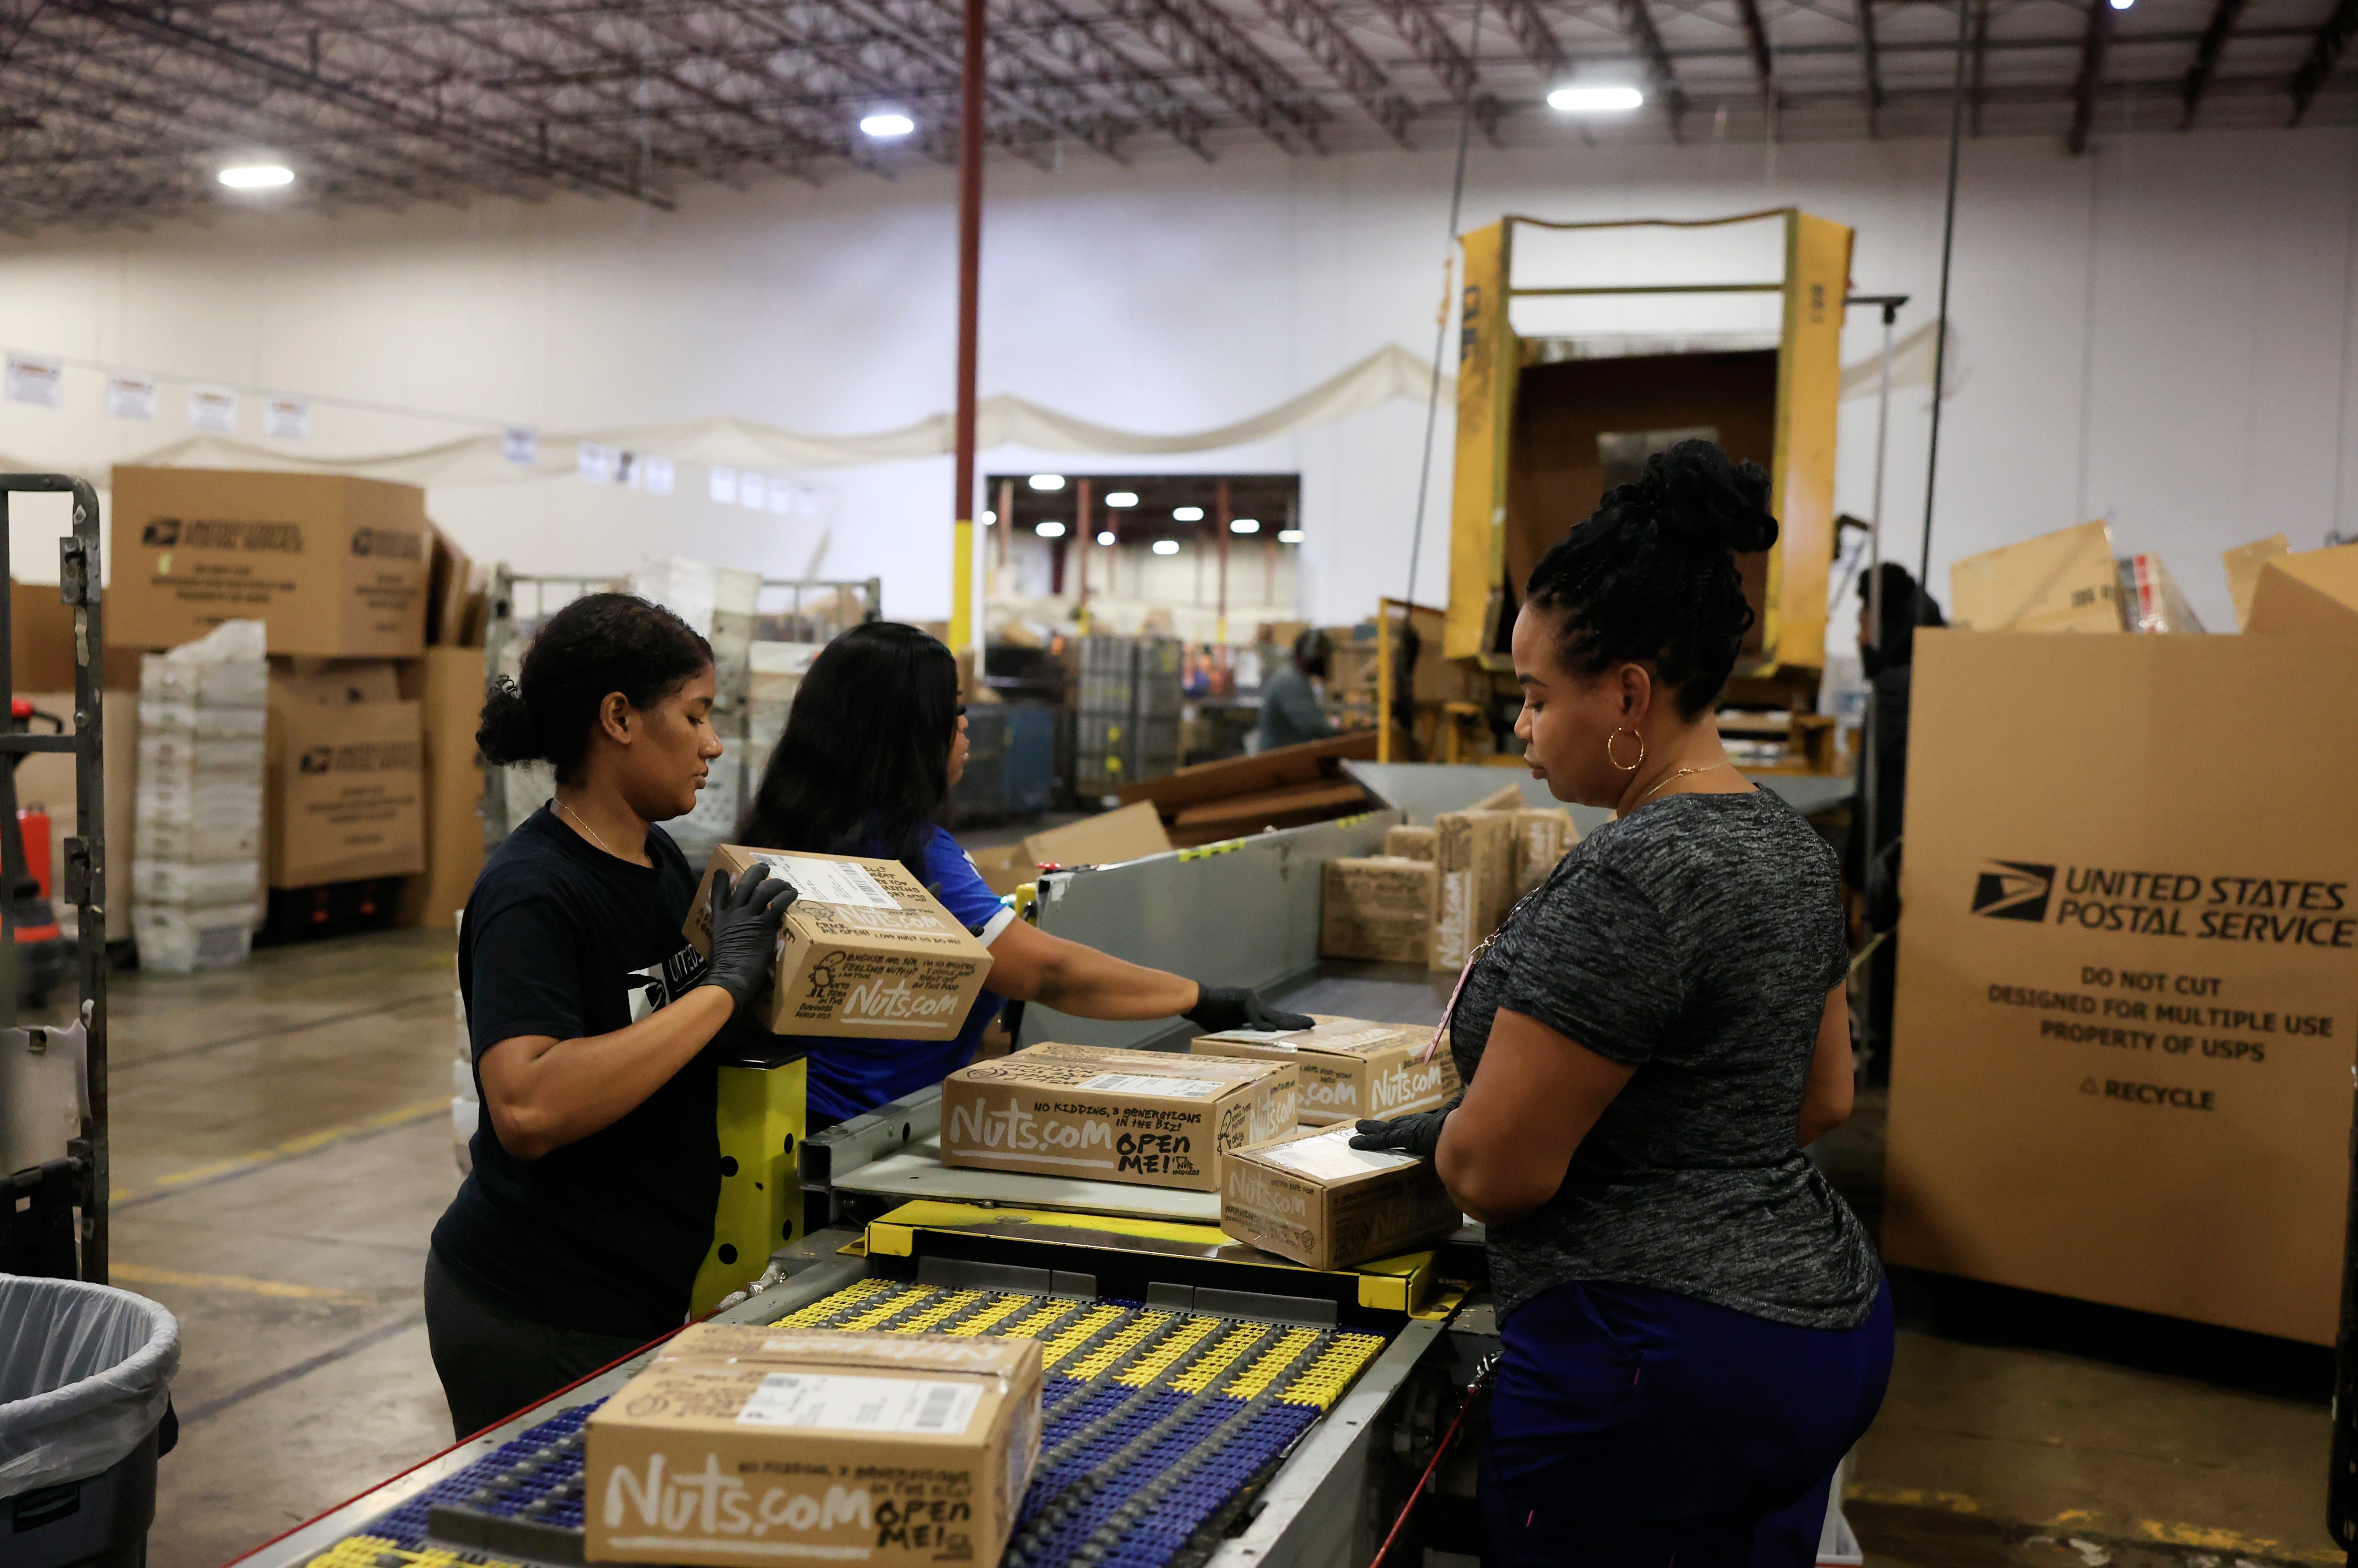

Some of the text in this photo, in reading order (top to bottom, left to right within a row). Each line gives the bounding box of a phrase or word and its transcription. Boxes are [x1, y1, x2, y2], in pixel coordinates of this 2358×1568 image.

[2066, 867, 2347, 911] UNITED STATES
[2057, 899, 2358, 947] POSTAL SERVICE
[2081, 966, 2222, 997] DO NOT CUT
[843, 979, 959, 1018] Nuts.com
[1988, 984, 2333, 1038] DESIGNED FOR MULTIPLE USE
[2041, 1020, 2266, 1063] PROPERTY OF USPS
[1372, 1063, 1441, 1111] Nuts.com
[2105, 1079, 2216, 1112] RECYCLE
[949, 1097, 1113, 1151] Nuts.com
[1034, 1102, 1202, 1124] NO KIDDING, 3 GENERATIONS
[1115, 1117, 1182, 1132] IN THE BIZ!
[1116, 1132, 1191, 1156] OPEN
[1117, 1153, 1170, 1175] ME!
[1302, 1187, 1315, 1195] FOR
[604, 1453, 870, 1536] Nuts.com
[875, 1500, 970, 1525] OPEN
[878, 1526, 945, 1550] ME!
